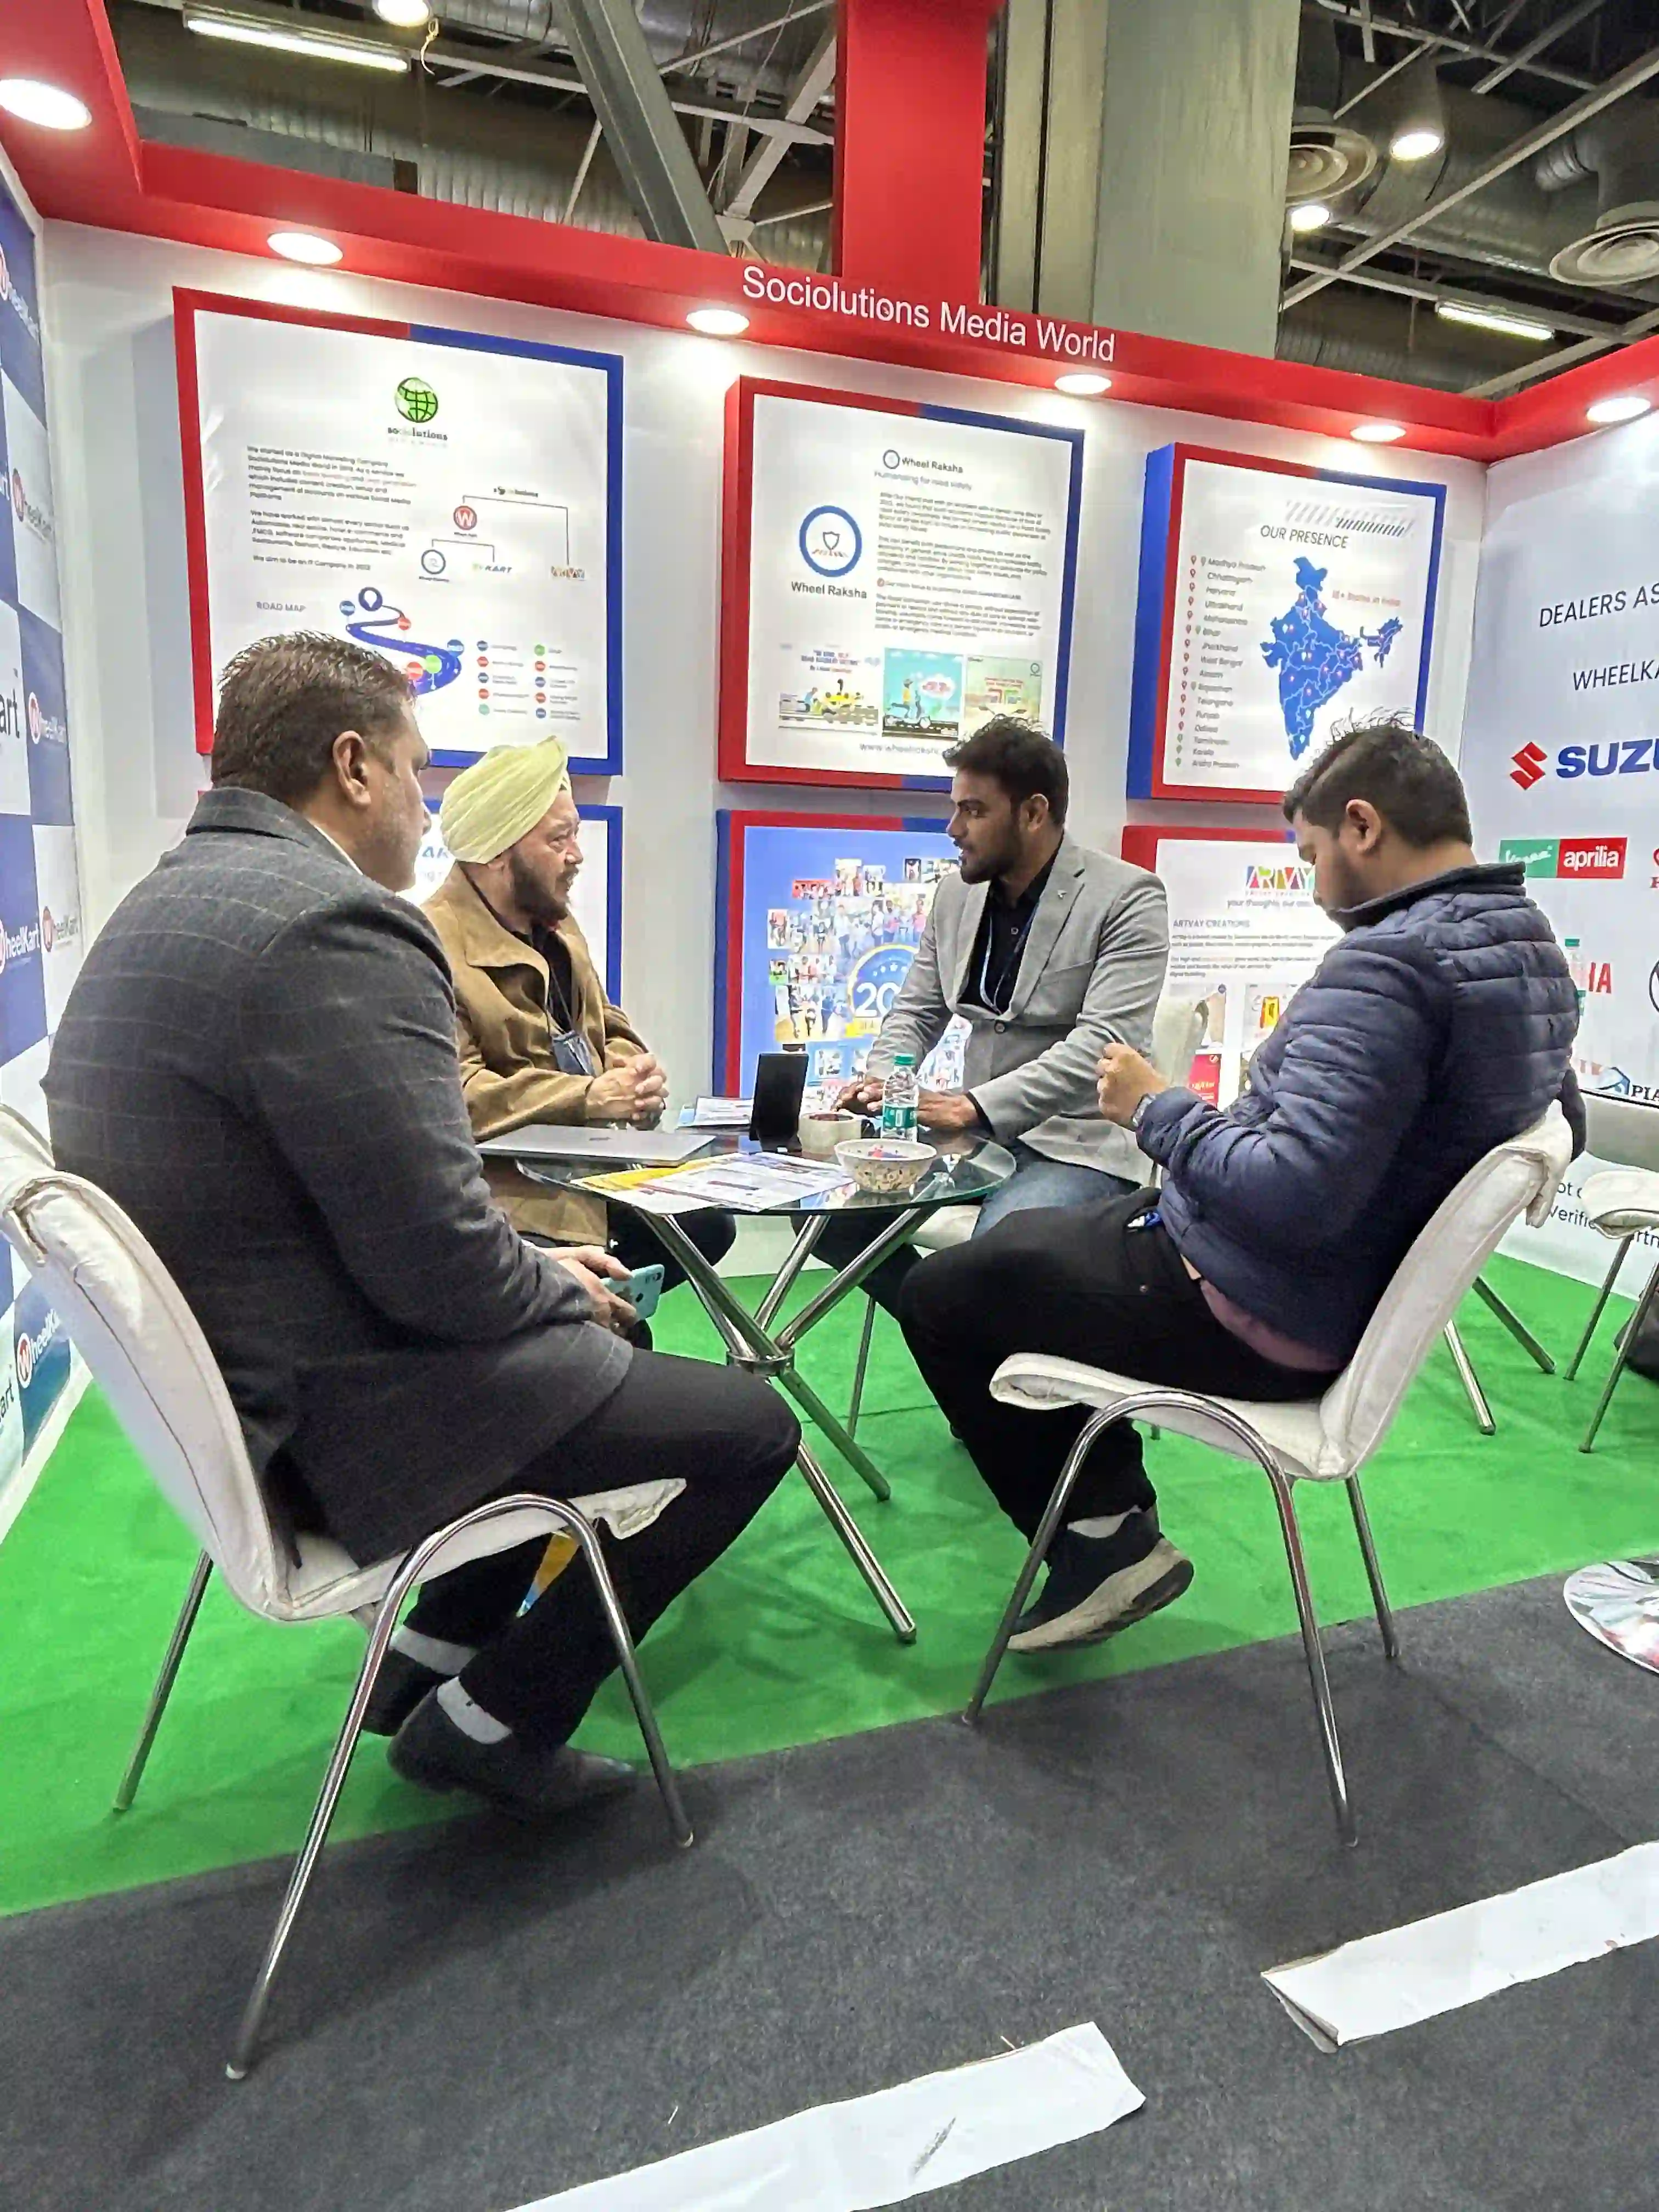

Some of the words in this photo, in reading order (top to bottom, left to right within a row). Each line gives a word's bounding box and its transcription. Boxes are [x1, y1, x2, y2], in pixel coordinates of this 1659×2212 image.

[743, 266, 930, 328] Sociolutions
[941, 301, 1026, 347] Media
[1036, 319, 1115, 363] World
[902, 456, 929, 469] Wheel
[932, 461, 963, 473] Raksha
[1261, 525, 1286, 540] OUR
[1289, 528, 1349, 549] PRESENCE
[791, 580, 825, 595] Wheel
[827, 585, 867, 599] Raksha
[256, 601, 283, 612] ROAD
[285, 603, 306, 612] MAP
[1539, 591, 1626, 627] DEALERS
[1556, 738, 1659, 778] SUZ
[1563, 845, 1620, 871] aprilia
[1173, 919, 1204, 928] ARTVAY
